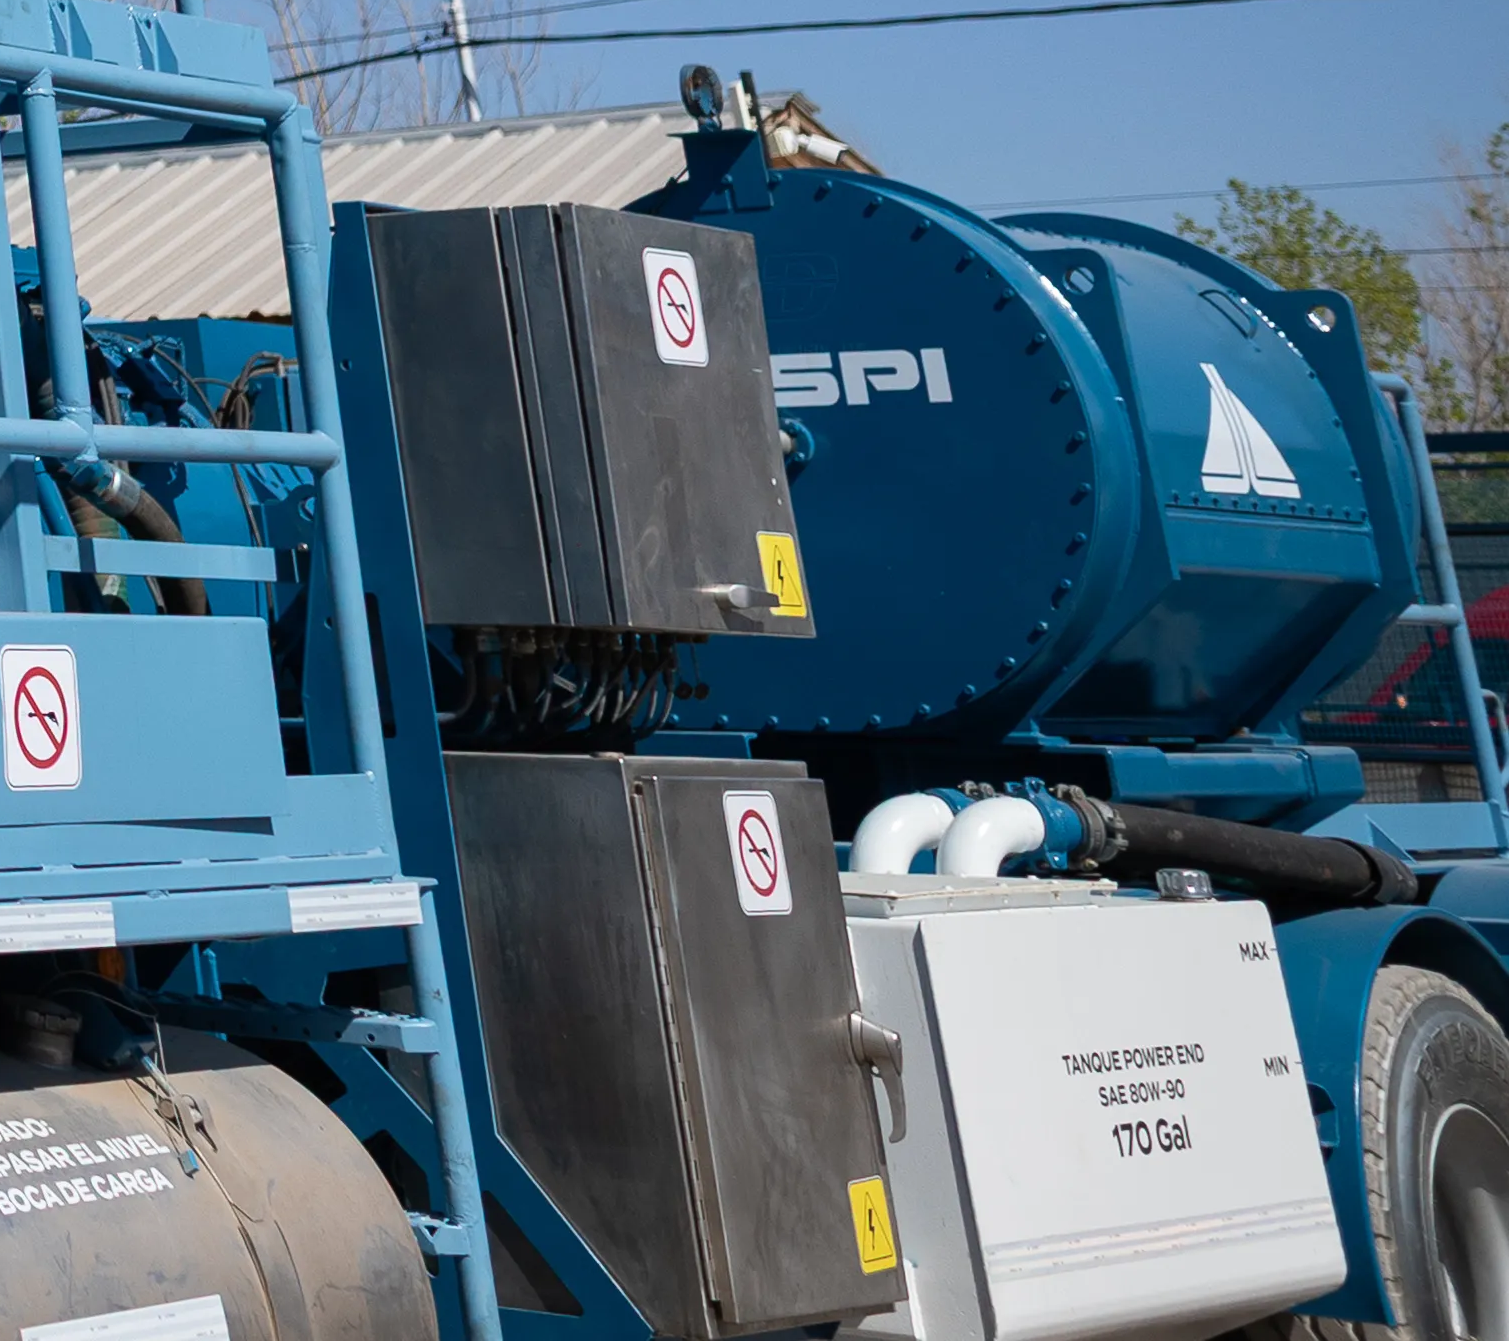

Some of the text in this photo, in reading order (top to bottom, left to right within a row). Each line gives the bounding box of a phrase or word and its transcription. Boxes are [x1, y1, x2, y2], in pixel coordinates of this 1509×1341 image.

[770, 347, 953, 407] SPI
[1238, 941, 1271, 962] MAX
[1061, 1043, 1205, 1076] TANQUE POWER END
[1262, 1055, 1290, 1077] MIN
[1098, 1078, 1186, 1107] SAE 80W-90
[73, 1142, 107, 1167] EL
[96, 1133, 171, 1162] NIVEL
[1111, 1114, 1192, 1158] 170 Gal
[56, 1176, 98, 1205] DE
[90, 1167, 175, 1199] CARGA
